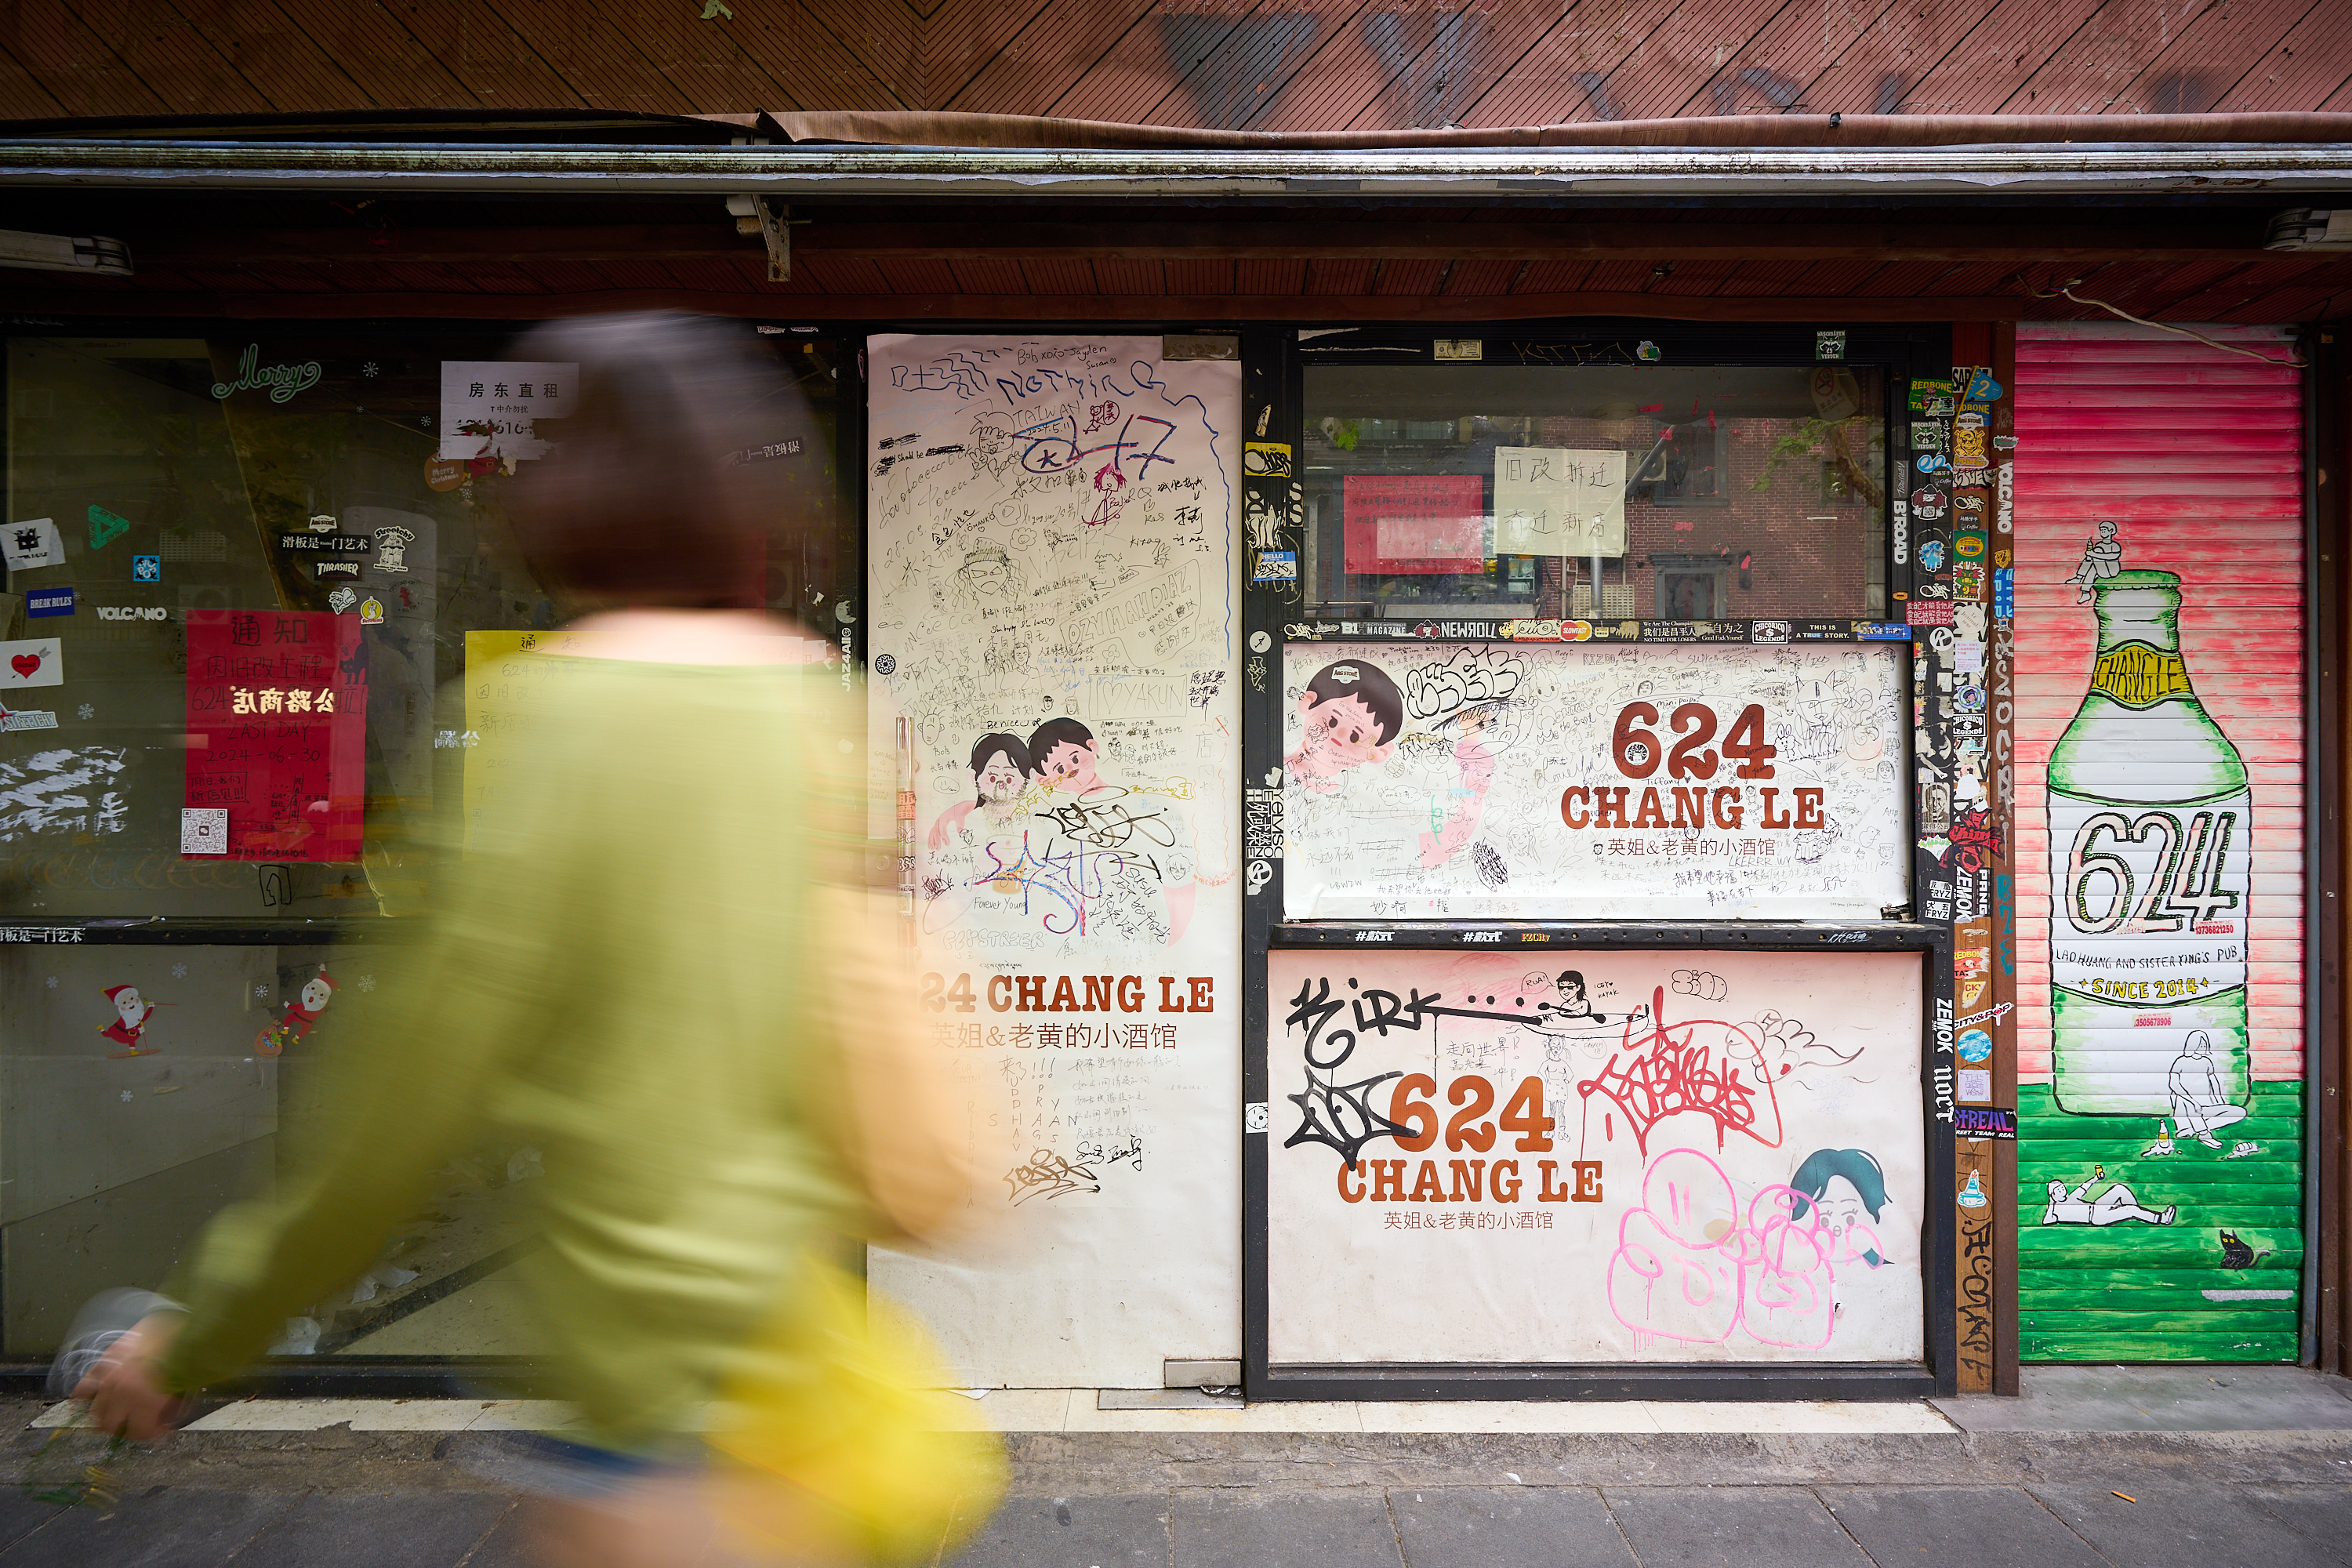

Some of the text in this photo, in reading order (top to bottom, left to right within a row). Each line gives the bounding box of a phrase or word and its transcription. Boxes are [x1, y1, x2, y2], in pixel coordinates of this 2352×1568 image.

[212, 343, 321, 403] Merry
[469, 381, 559, 399] 房东直租
[1911, 380, 1953, 394] REDBONE
[497, 405, 528, 414] 中介勿扰
[1012, 401, 1081, 427] TAIWAN
[430, 473, 459, 485] Christmas
[432, 466, 456, 477] Merry
[1506, 457, 1616, 492] 旧改拆迁
[1998, 462, 2013, 534] VOLCANO
[375, 526, 415, 541] Streetchy
[317, 562, 359, 576] THRASHER
[30, 596, 72, 609] BREAK RULES
[96, 606, 168, 621] VOLCANO
[231, 615, 308, 647] 通知
[1367, 626, 1406, 635] MAGAZINE
[1643, 627, 1697, 637] 我们是昌平人
[1755, 622, 1785, 633] CHICORICO
[3, 712, 57, 730] STREETCHY
[1613, 701, 1777, 780] 624
[1560, 786, 1824, 830] CHANG LE
[1607, 837, 1776, 857] 英姐&老黄的小酒馆
[2065, 811, 2239, 935] 624
[973, 896, 1028, 916] Forever Young
[1926, 909, 1950, 920] FRYZ
[1355, 931, 1396, 942] #款式
[2195, 924, 2234, 935] 13736821250
[2115, 957, 2136, 969] AND
[2139, 956, 2175, 969] SISTER
[2177, 951, 2210, 967] YING'S
[2217, 946, 2238, 962] PUB
[920, 971, 1214, 1014] 24 CHANG LE
[2092, 978, 2199, 1000] SINCE 2014
[1936, 997, 1954, 1054] ZEMOK
[2133, 1018, 2172, 1027] 3505678906
[928, 1022, 1178, 1051] 英姐&老黄的小酒馆
[1388, 1073, 1556, 1153] 624
[1338, 1159, 1603, 1203] CHANG LE
[1384, 1210, 1554, 1230] 英姐&老黄的小酒馆
